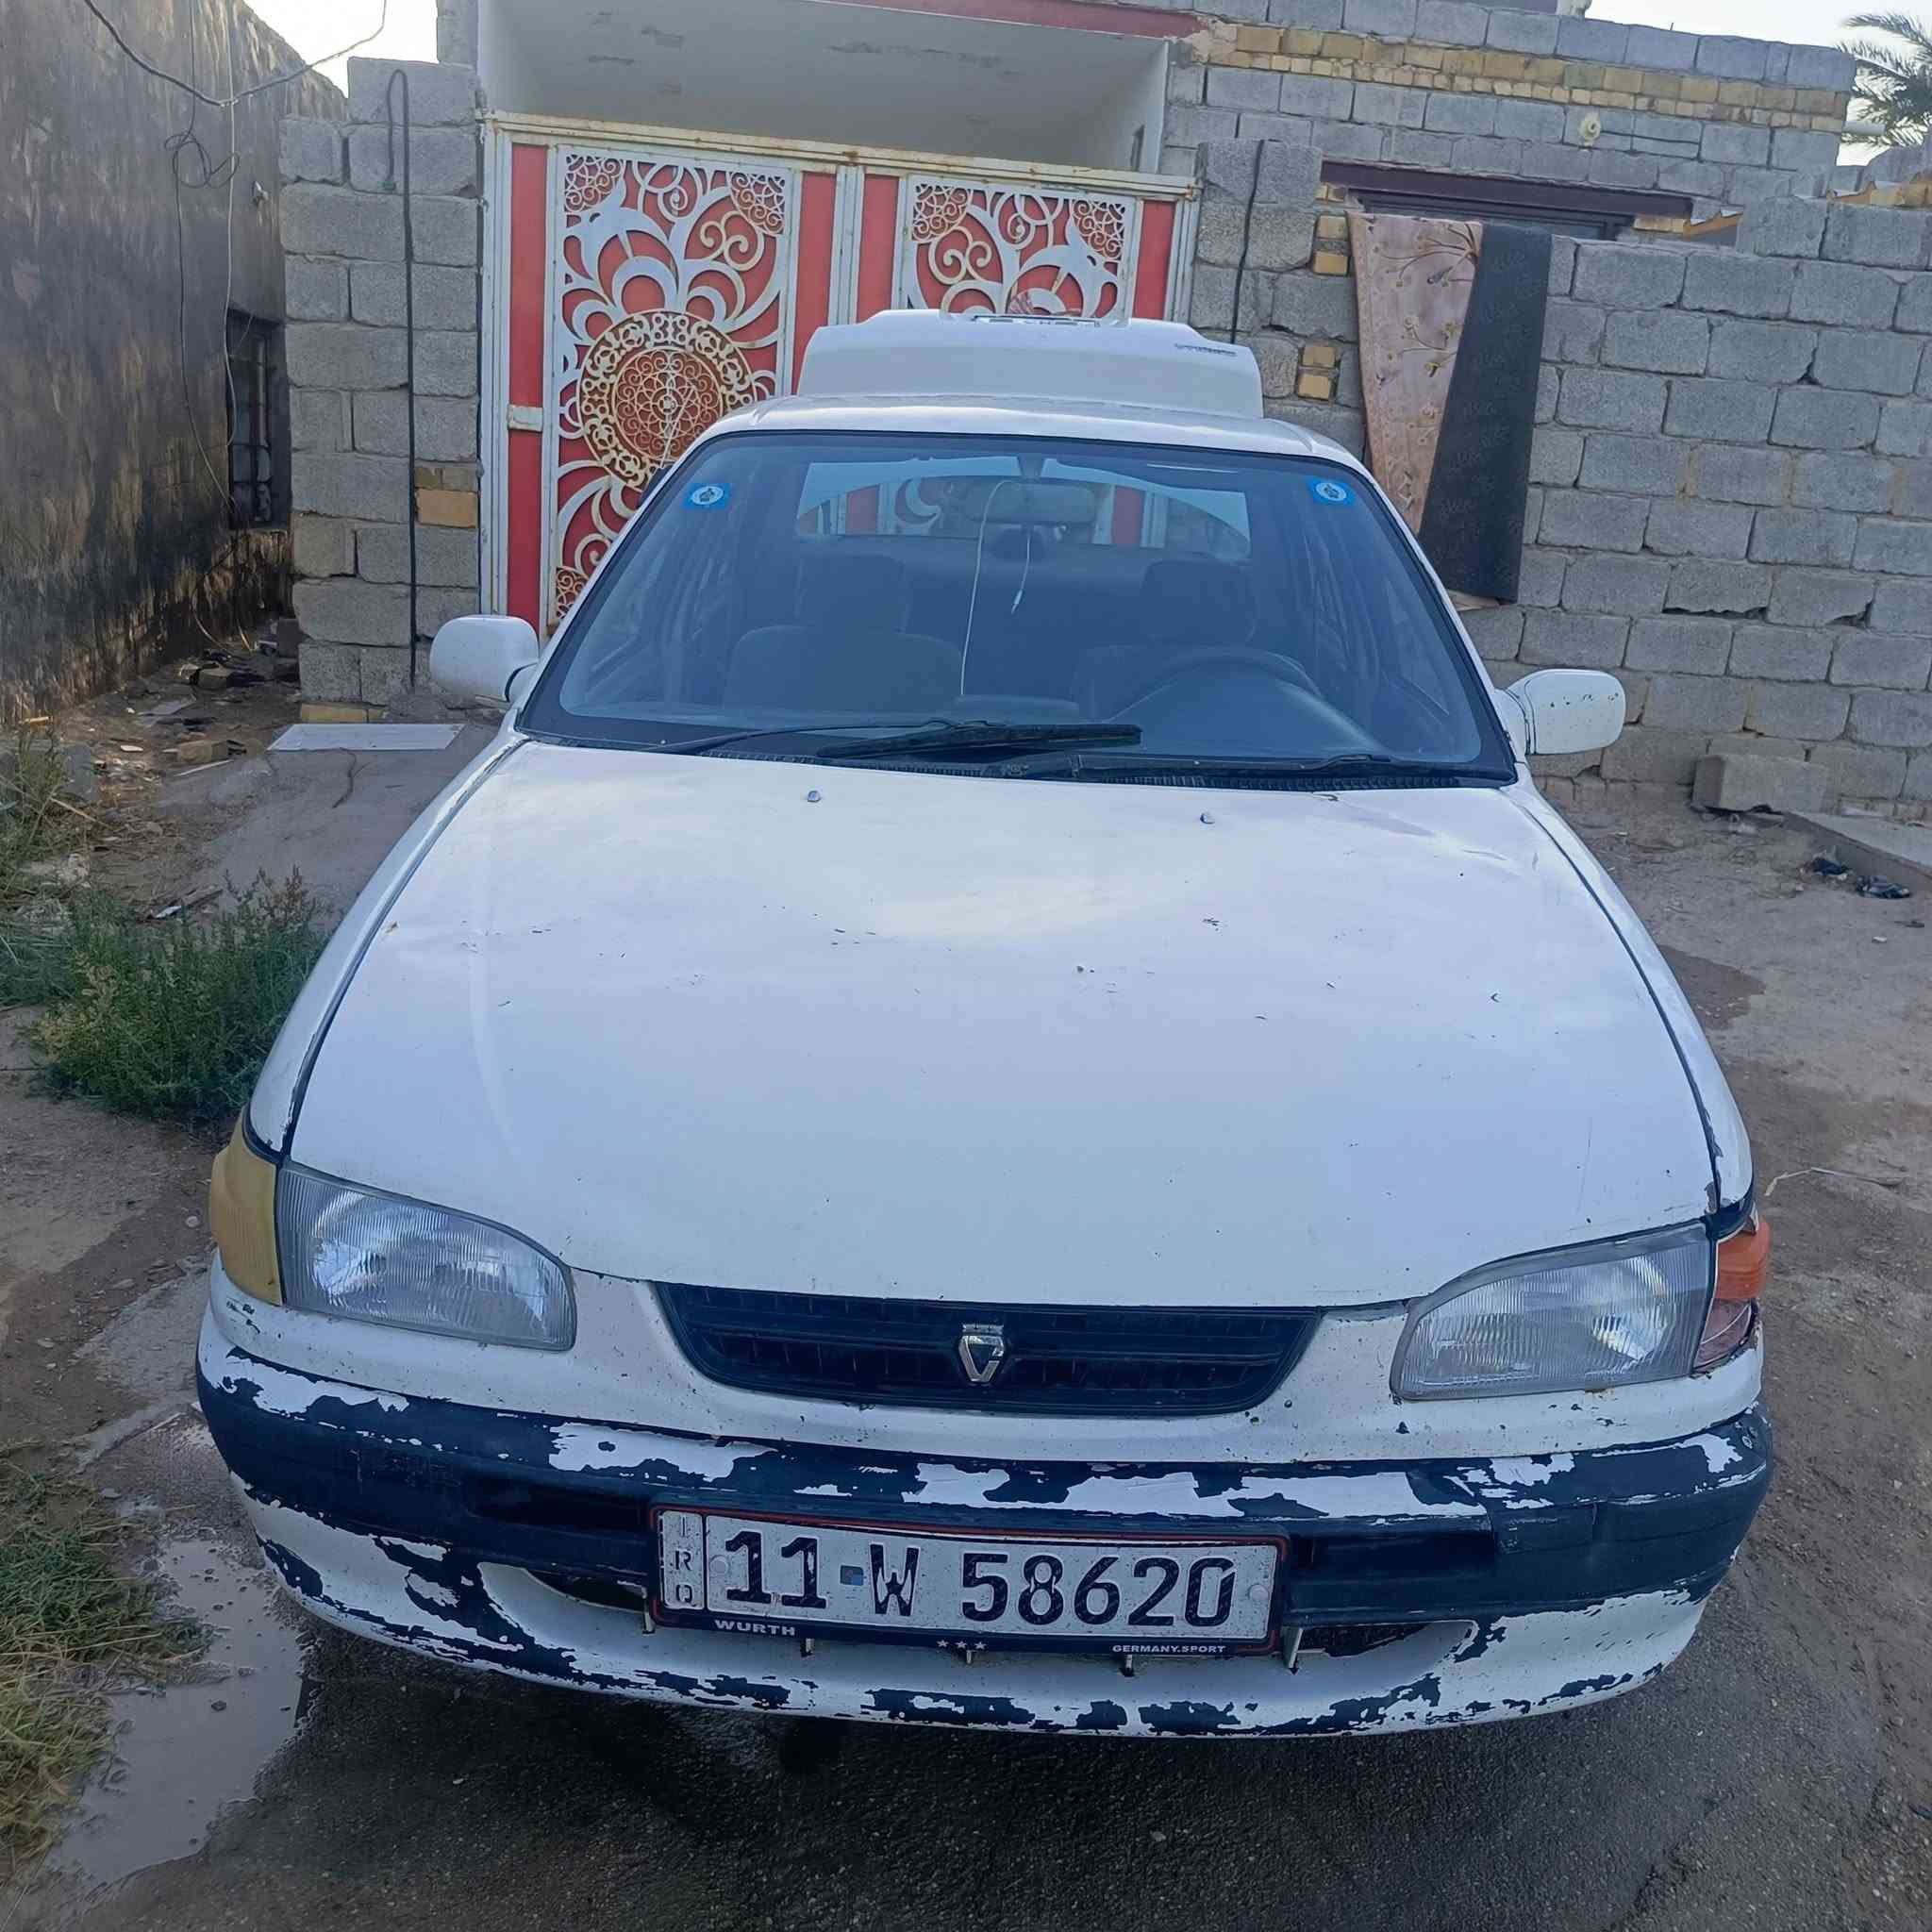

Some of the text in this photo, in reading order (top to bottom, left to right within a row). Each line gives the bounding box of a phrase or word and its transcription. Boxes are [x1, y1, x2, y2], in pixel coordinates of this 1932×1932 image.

[724, 1530, 1237, 1626] 11 W 58620
[714, 1619, 796, 1637] WURTH
